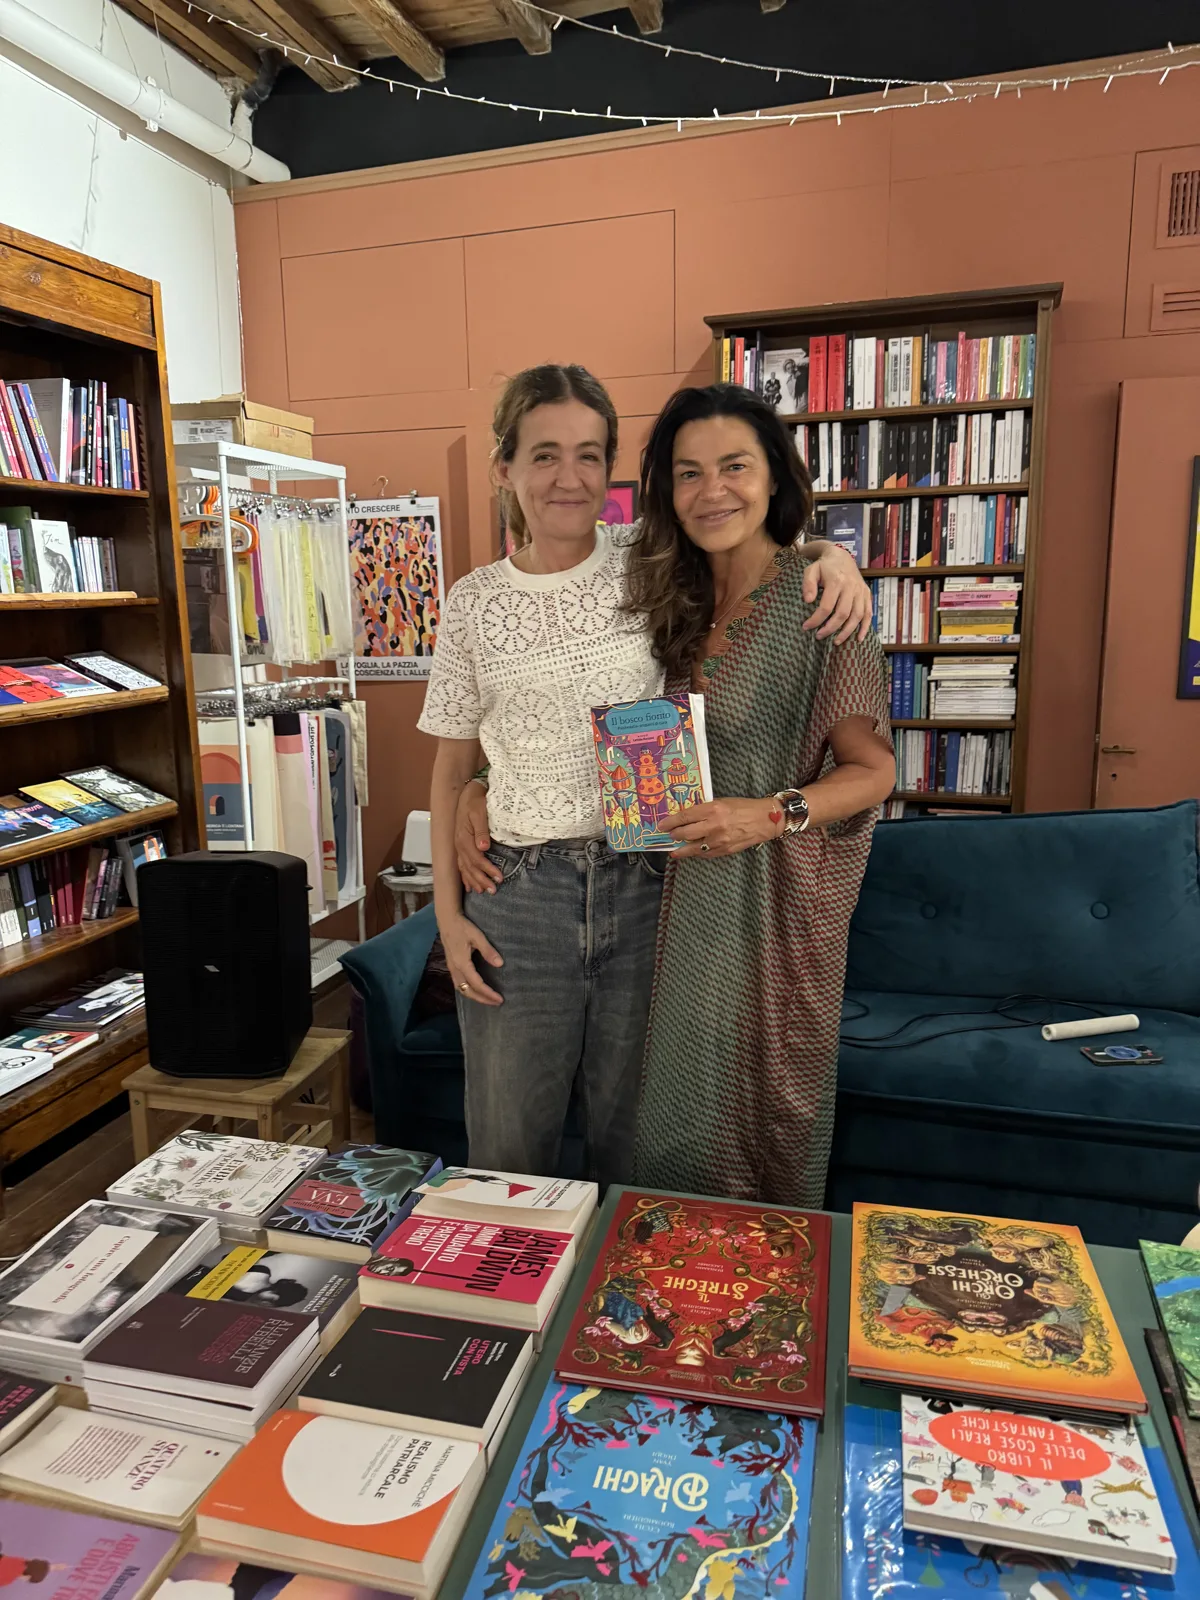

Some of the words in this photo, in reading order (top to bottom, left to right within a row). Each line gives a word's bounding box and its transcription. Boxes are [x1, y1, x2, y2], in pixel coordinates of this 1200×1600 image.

[362, 505, 400, 513] CRESCERE
[611, 717, 617, 725] Il
[620, 716, 643, 725] bosco
[646, 711, 671, 721] fiorito
[217, 1158, 244, 1183] ERBE
[307, 1189, 349, 1205] EVA
[405, 1224, 434, 1245] TRENO
[462, 1223, 482, 1232] DA
[471, 1226, 500, 1246] DIMMI
[421, 1226, 456, 1253] PARTITO
[438, 1231, 476, 1262] QUANTO
[465, 1228, 523, 1292] BALDWIN
[509, 1232, 563, 1279] JAMES
[926, 1264, 1023, 1287] ORCHESSE
[663, 1276, 749, 1300] STREGHE
[697, 1292, 709, 1303] LE
[952, 1280, 1015, 1299] ORCHI
[229, 1317, 283, 1366] RIBELLI
[234, 1318, 295, 1375] ALLEANZE
[466, 1338, 482, 1355] CON
[470, 1340, 492, 1365] UTERO
[453, 1353, 473, 1376] VISTA
[951, 1428, 991, 1446] REALI
[959, 1415, 1054, 1440] FANTASTICHE
[1063, 1431, 1071, 1443] E
[999, 1436, 1035, 1453] COSE
[1043, 1442, 1086, 1460] DELLE
[125, 1439, 168, 1479] STANZE
[130, 1442, 180, 1491] QUATTRO
[374, 1438, 420, 1499] PATRIARCALE
[397, 1440, 431, 1485] REALISMO
[432, 1444, 455, 1474] MARTINA
[652, 1458, 671, 1466] YVAN
[987, 1449, 1031, 1468] LIBRO
[1039, 1457, 1052, 1470] IL
[592, 1465, 709, 1512] DRAGHI
[67, 1548, 108, 1581] DOVE
[87, 1533, 141, 1585] ABILISTI
